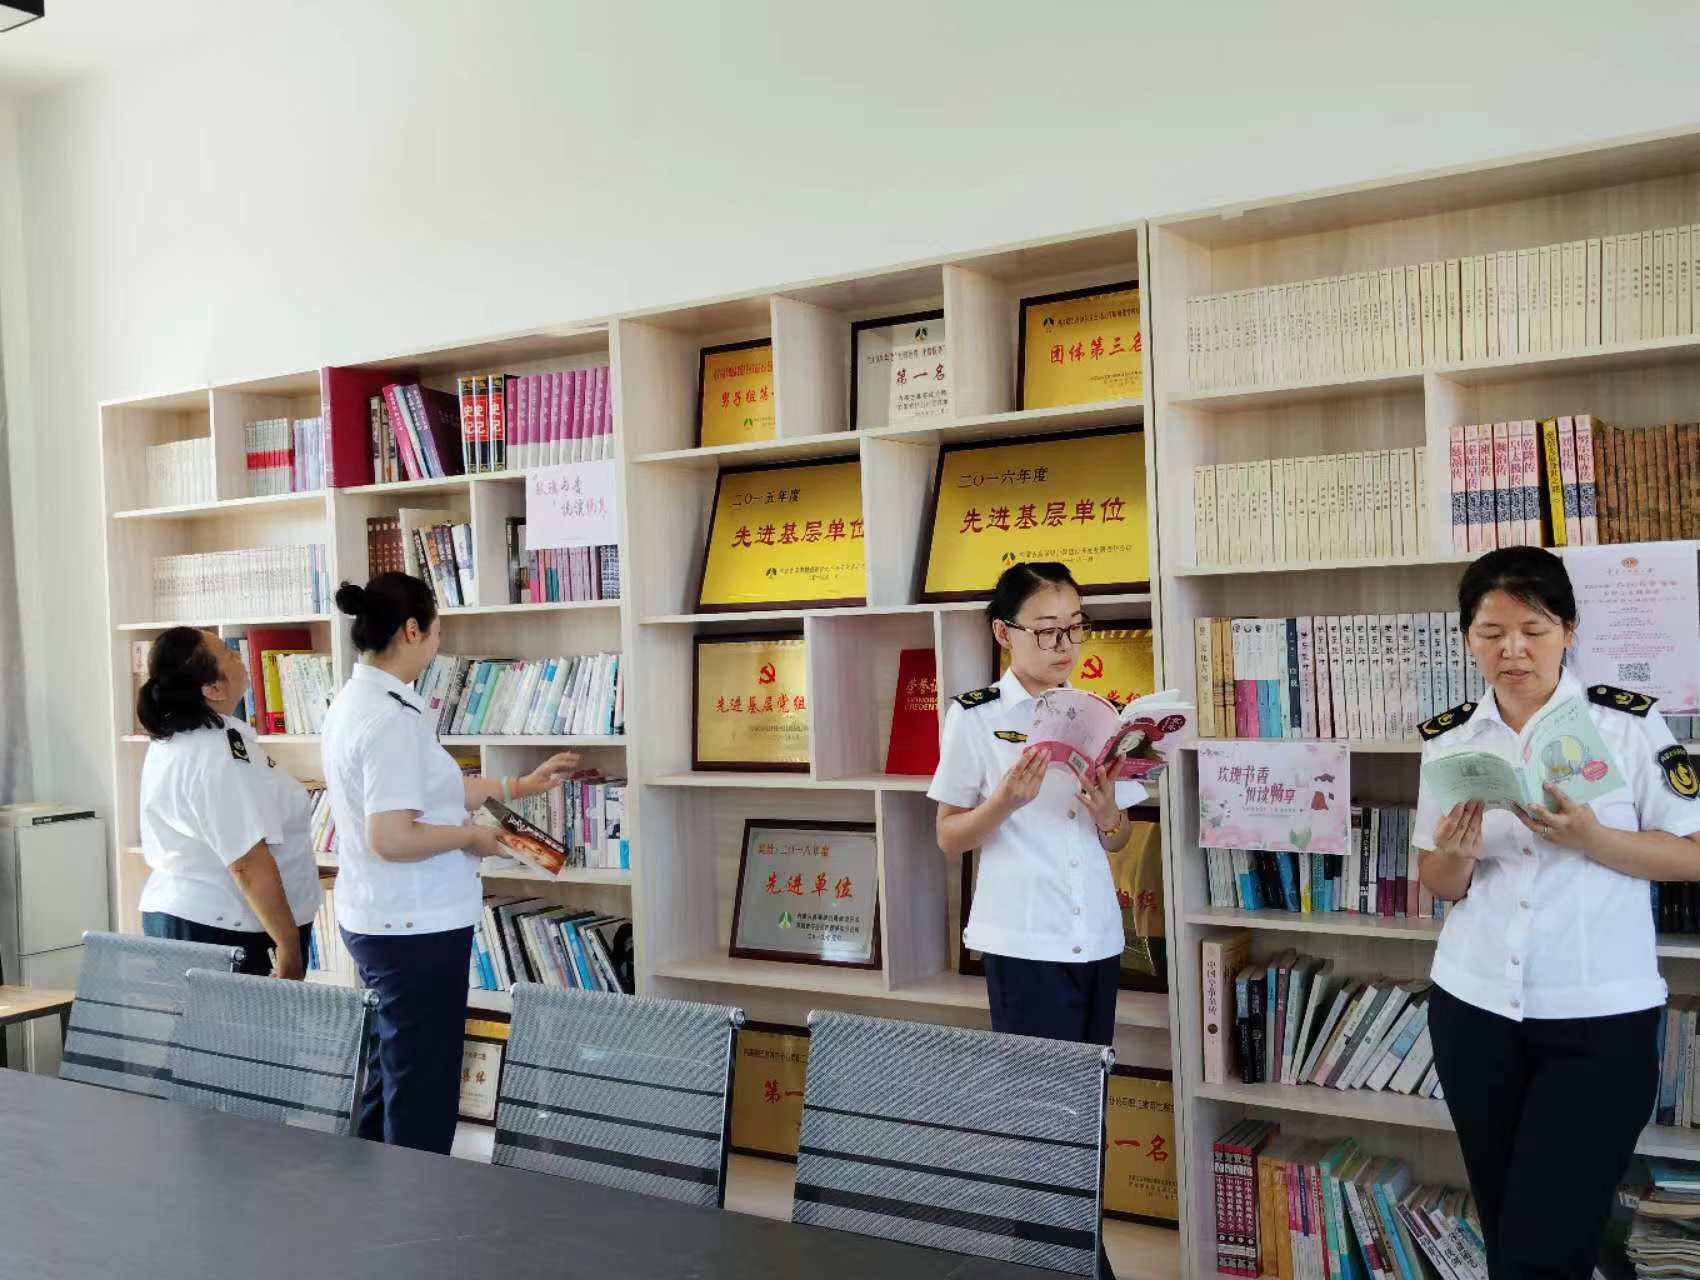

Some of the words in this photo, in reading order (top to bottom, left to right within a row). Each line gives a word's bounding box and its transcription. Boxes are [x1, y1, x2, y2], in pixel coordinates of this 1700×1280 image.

[896, 363, 944, 385] 第一名
[720, 385, 775, 409] 男子组第
[959, 496, 1126, 534] 先进基层单位
[731, 518, 865, 549] 先进基层单位
[715, 693, 808, 714] 先进基层党组
[766, 871, 854, 899] 先进单位
[1104, 1133, 1169, 1162] 一名
